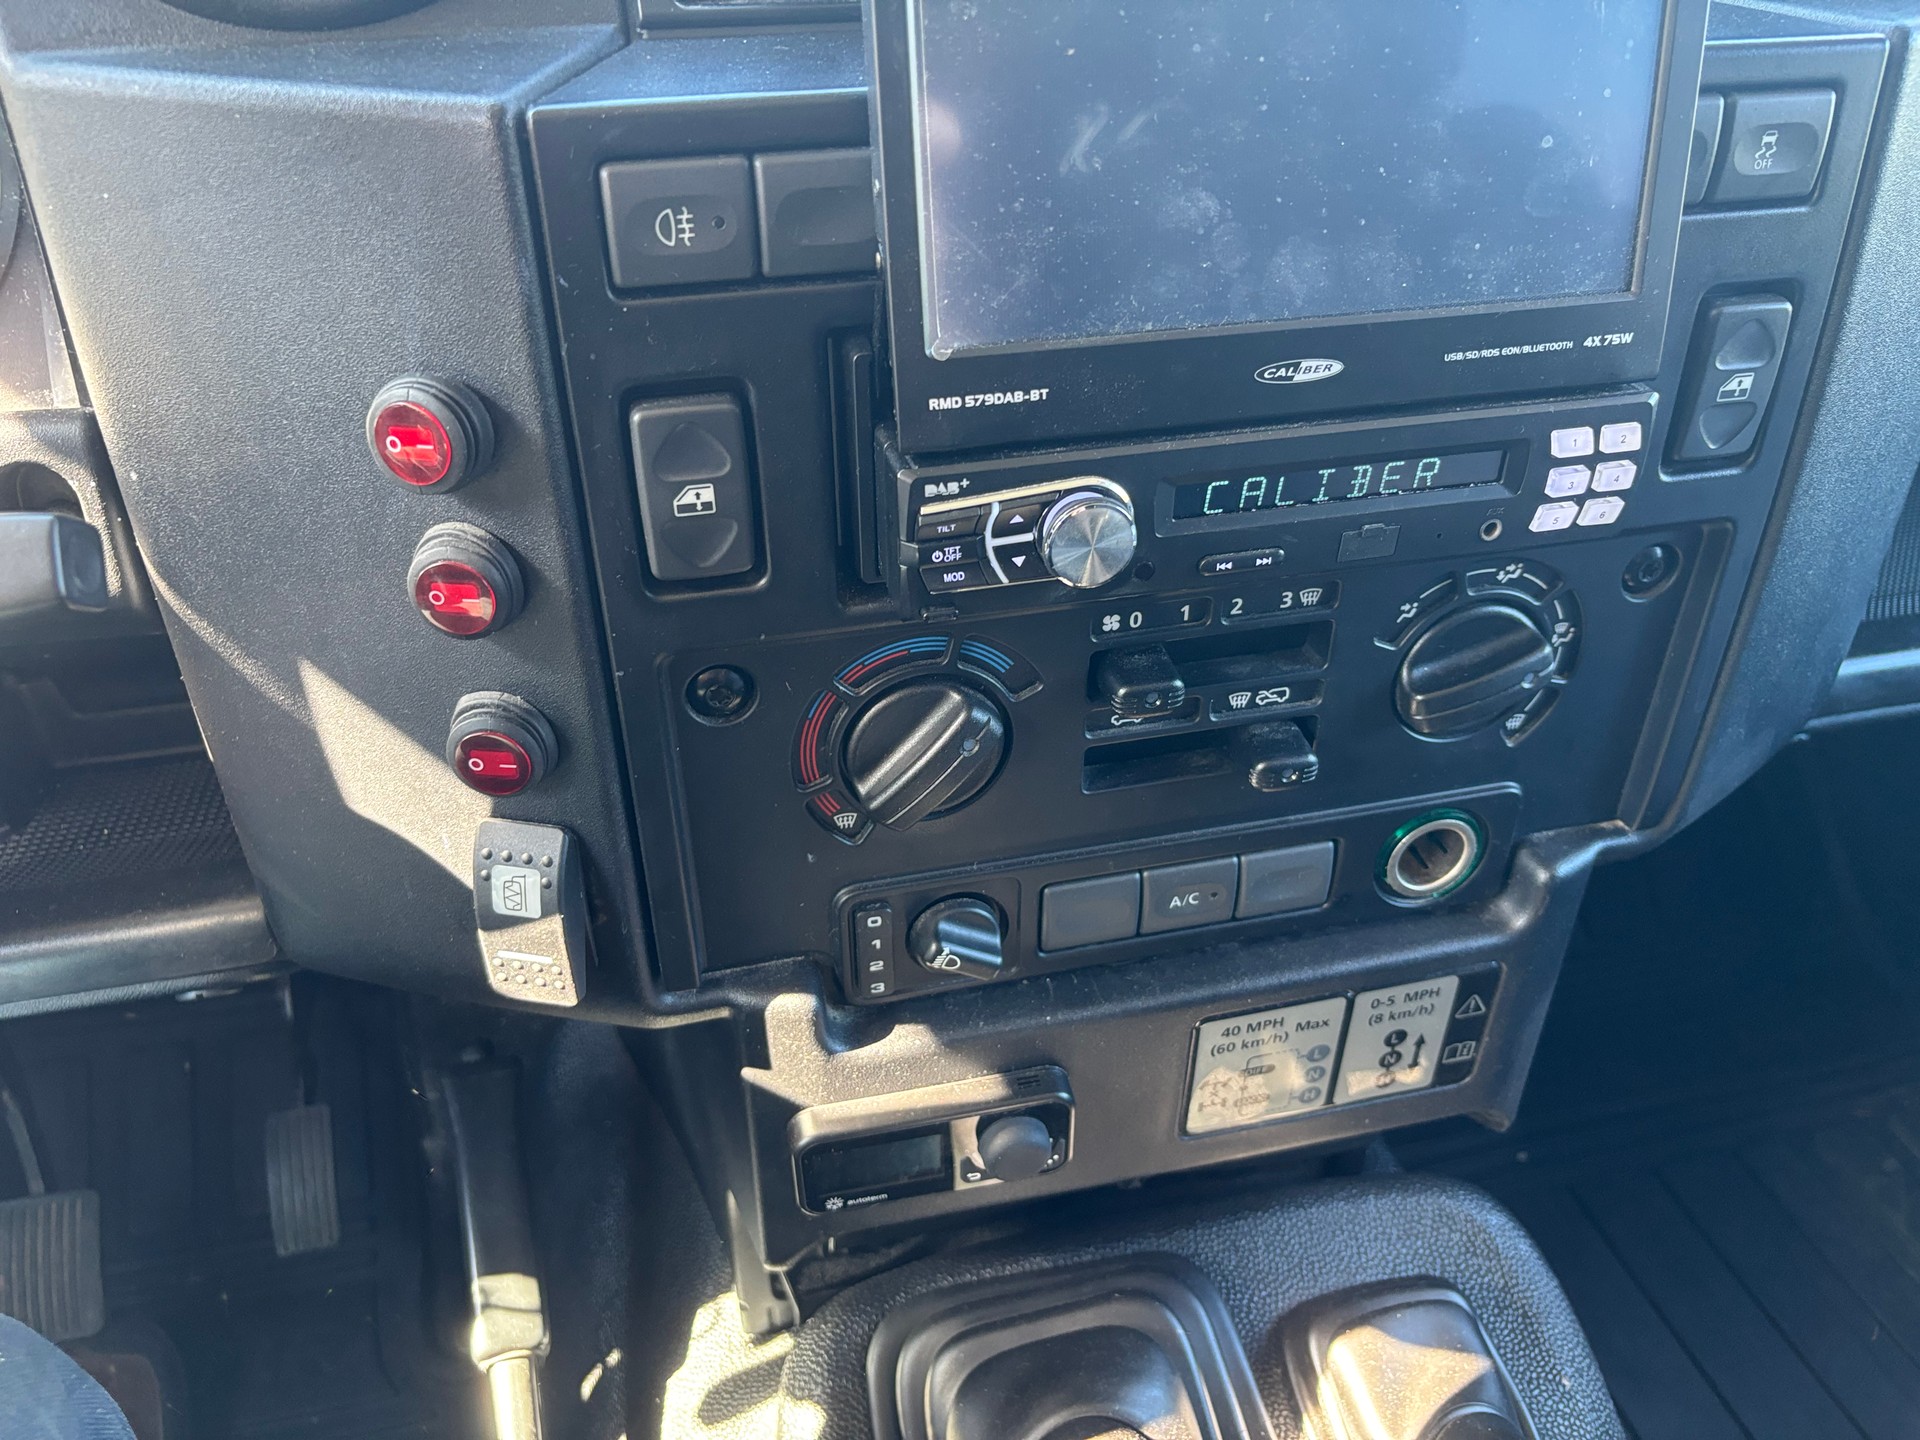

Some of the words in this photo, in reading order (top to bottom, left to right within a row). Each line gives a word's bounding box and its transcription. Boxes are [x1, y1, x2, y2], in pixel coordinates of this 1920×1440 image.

[1754, 158, 1773, 170] OFF
[1502, 341, 1573, 356] EON/BLUETOOTH
[1263, 362, 1333, 380] CALIBER
[929, 397, 962, 411] RMD
[965, 388, 1049, 408] 579DAB-BT
[1620, 434, 1627, 444] 2
[1613, 475, 1620, 483] 4
[1203, 457, 1441, 515] CALIBER
[1567, 481, 1575, 490] 3
[1552, 516, 1560, 525] 5
[1599, 511, 1606, 519] 6
[937, 524, 957, 534] TILT
[944, 546, 961, 555] TFT
[944, 553, 962, 563] OFF
[943, 571, 966, 583] MOD
[1180, 604, 1190, 621] 1
[1229, 598, 1243, 615] 2
[1280, 591, 1293, 609] 3
[1169, 892, 1200, 909] A/C
[871, 939, 881, 950] 1
[869, 960, 884, 971] 2
[870, 982, 885, 994] 3
[1370, 994, 1397, 1010] 0-5
[1402, 987, 1441, 1004] MPH
[1368, 1012, 1384, 1027] (8
[1388, 1003, 1436, 1022] km/h)
[1220, 1024, 1241, 1039] 40
[1246, 1016, 1285, 1034] MPH
[1295, 1018, 1331, 1033] Max
[1210, 1041, 1236, 1058] (60
[1240, 1031, 1290, 1052] km/h)
[846, 1193, 889, 1206] autoterm
